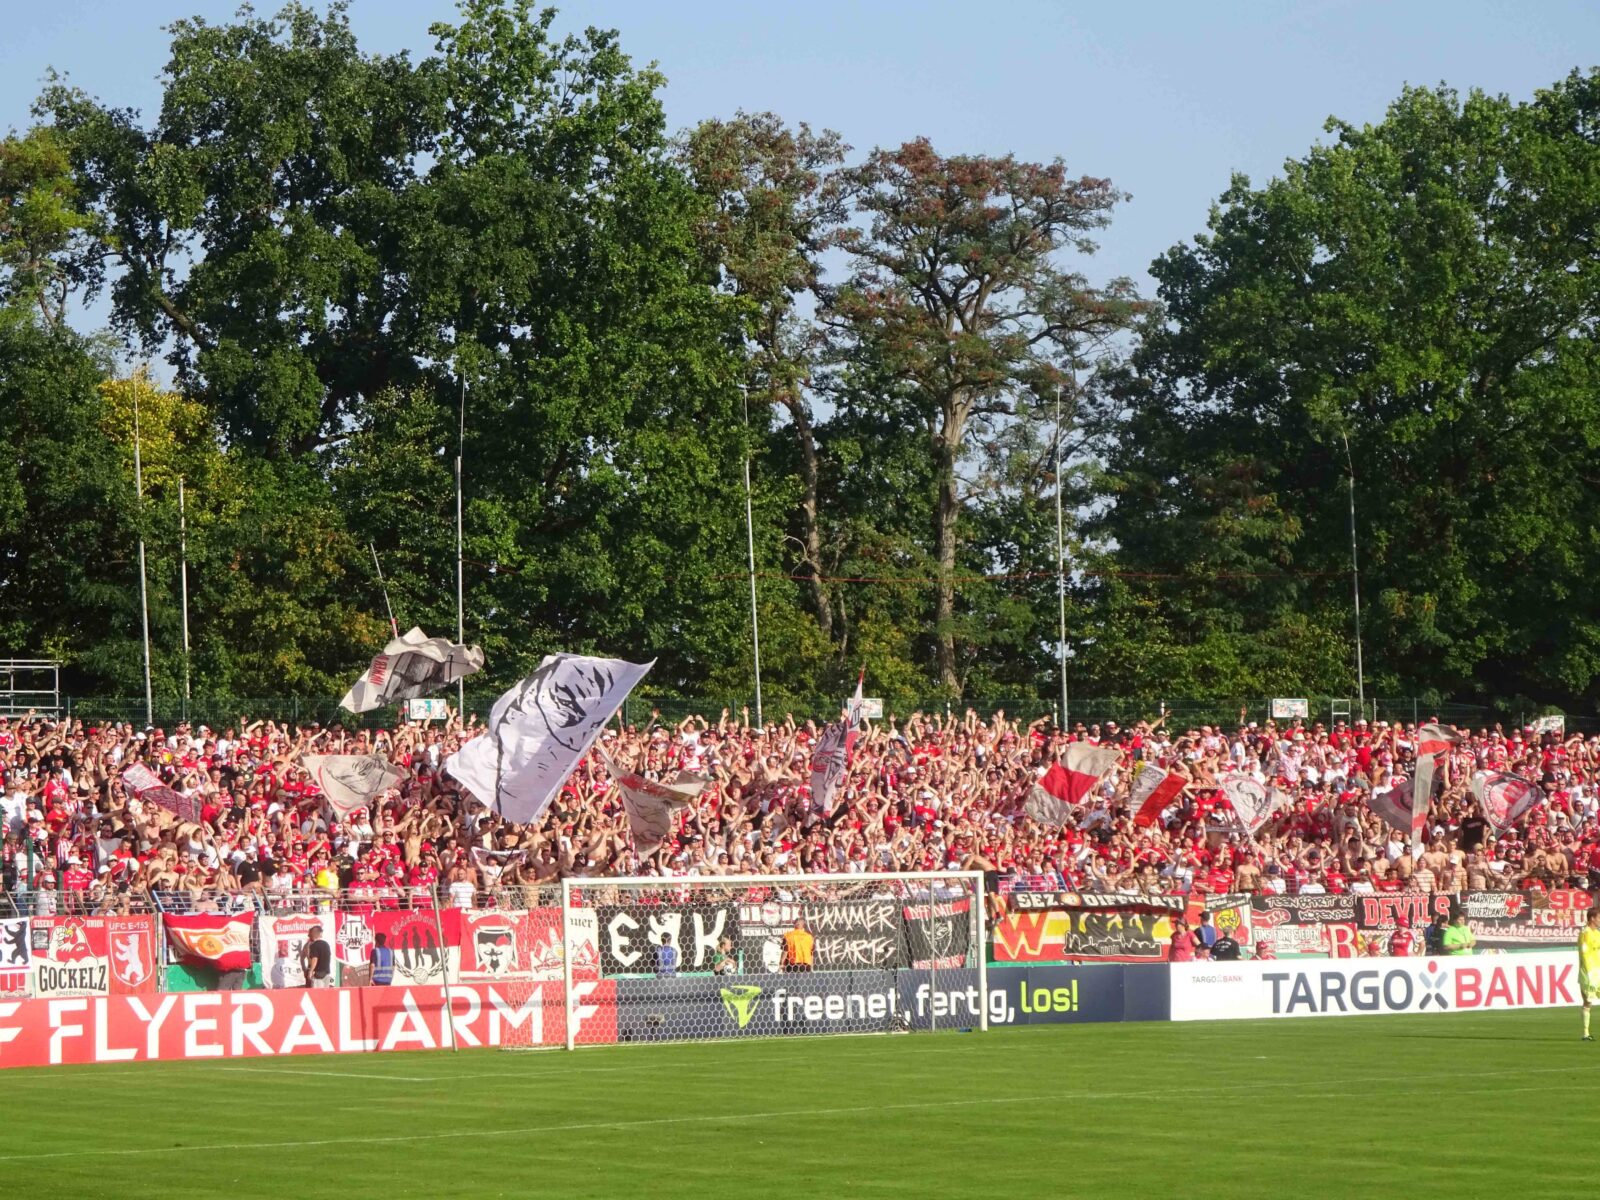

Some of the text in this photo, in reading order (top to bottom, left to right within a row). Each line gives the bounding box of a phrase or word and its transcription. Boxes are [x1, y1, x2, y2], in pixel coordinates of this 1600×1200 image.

[804, 904, 896, 932] HAMMER
[1363, 896, 1450, 926] DEVILS
[1468, 920, 1580, 937] Oberschöneweide
[815, 936, 896, 965] HEARTS
[39, 964, 107, 992] GOCKELZ
[1192, 975, 1243, 984] TARGO BANK
[1262, 964, 1574, 1013] TARGO BANK
[916, 984, 1015, 1023] fertg,
[1020, 980, 1078, 1013] los!
[48, 985, 543, 1065] FLYERALARM
